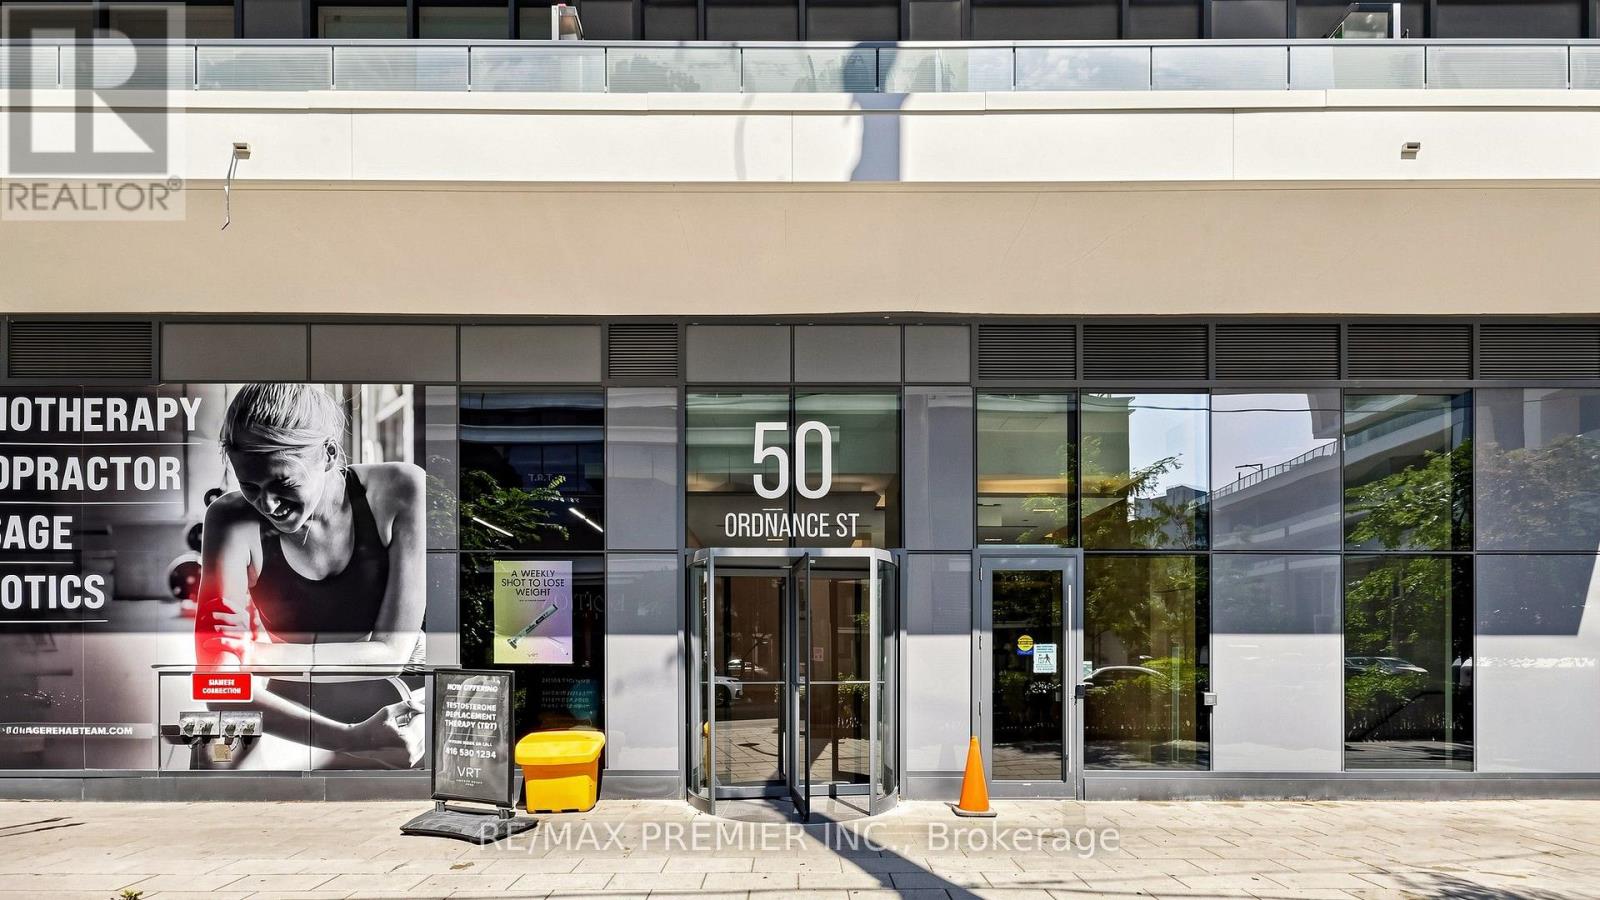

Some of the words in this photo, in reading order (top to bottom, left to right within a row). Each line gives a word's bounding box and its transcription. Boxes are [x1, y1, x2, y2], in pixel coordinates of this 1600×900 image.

[753, 420, 832, 499] 50
[724, 512, 831, 538] ORDNANCE
[836, 512, 860, 538] ST
[0, 514, 73, 550] AGE
[511, 569, 518, 577] A
[520, 569, 556, 578] WEEKLY
[501, 578, 526, 587] SHOT
[528, 578, 541, 587] TO
[543, 578, 565, 587] LOSE
[1, 574, 105, 610] OTICS
[515, 588, 551, 597] WEIGHT
[447, 683, 462, 691] NOW
[463, 684, 499, 692] OFFERING
[446, 701, 497, 712] TESTOSTERONE
[445, 710, 497, 721] REPLACEMENT
[445, 719, 476, 728] THERAPY
[459, 748, 475, 757] 530
[476, 750, 497, 759] 1234
[457, 766, 482, 778] VRT
